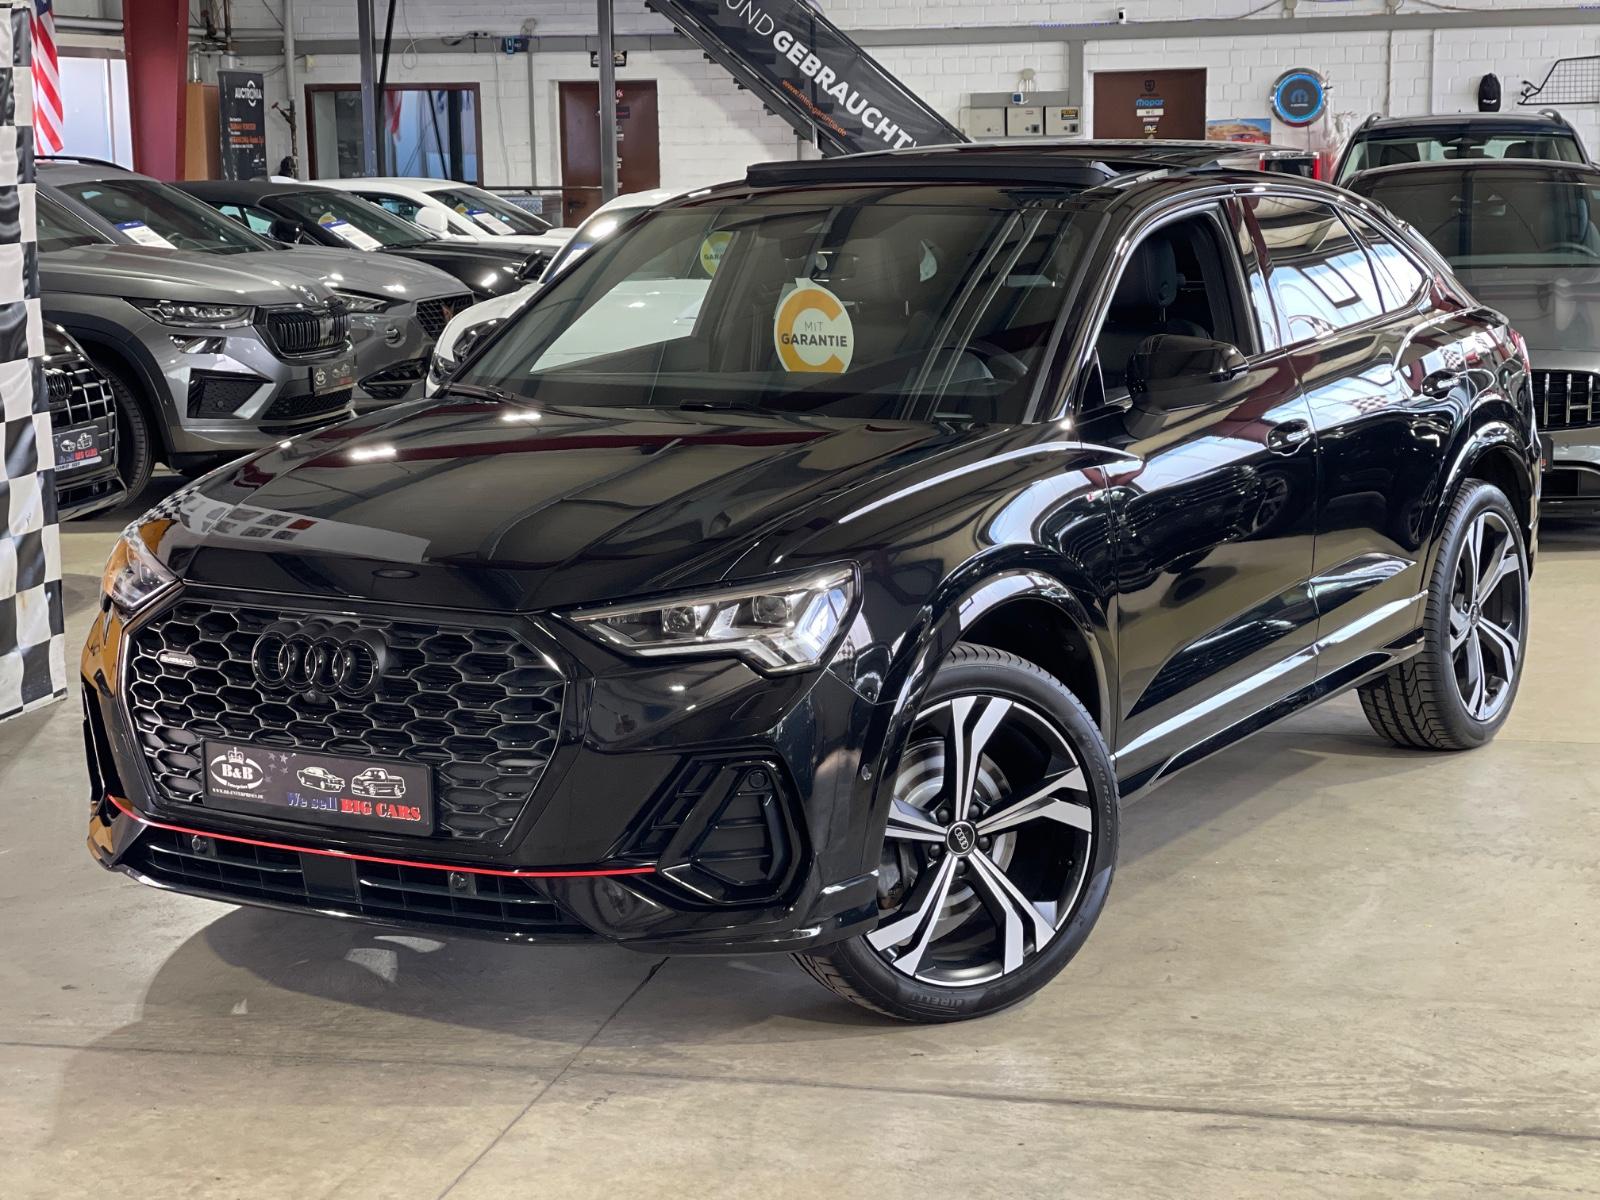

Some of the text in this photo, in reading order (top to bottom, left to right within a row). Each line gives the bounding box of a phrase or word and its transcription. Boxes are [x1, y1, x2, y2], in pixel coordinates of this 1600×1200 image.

[772, 30, 919, 150] GEBRAUCHT
[781, 333, 848, 347] GARANTIE
[221, 763, 254, 780] B&B
[311, 798, 338, 812] sell
[340, 798, 373, 815] BIG
[375, 802, 421, 822] CARS
